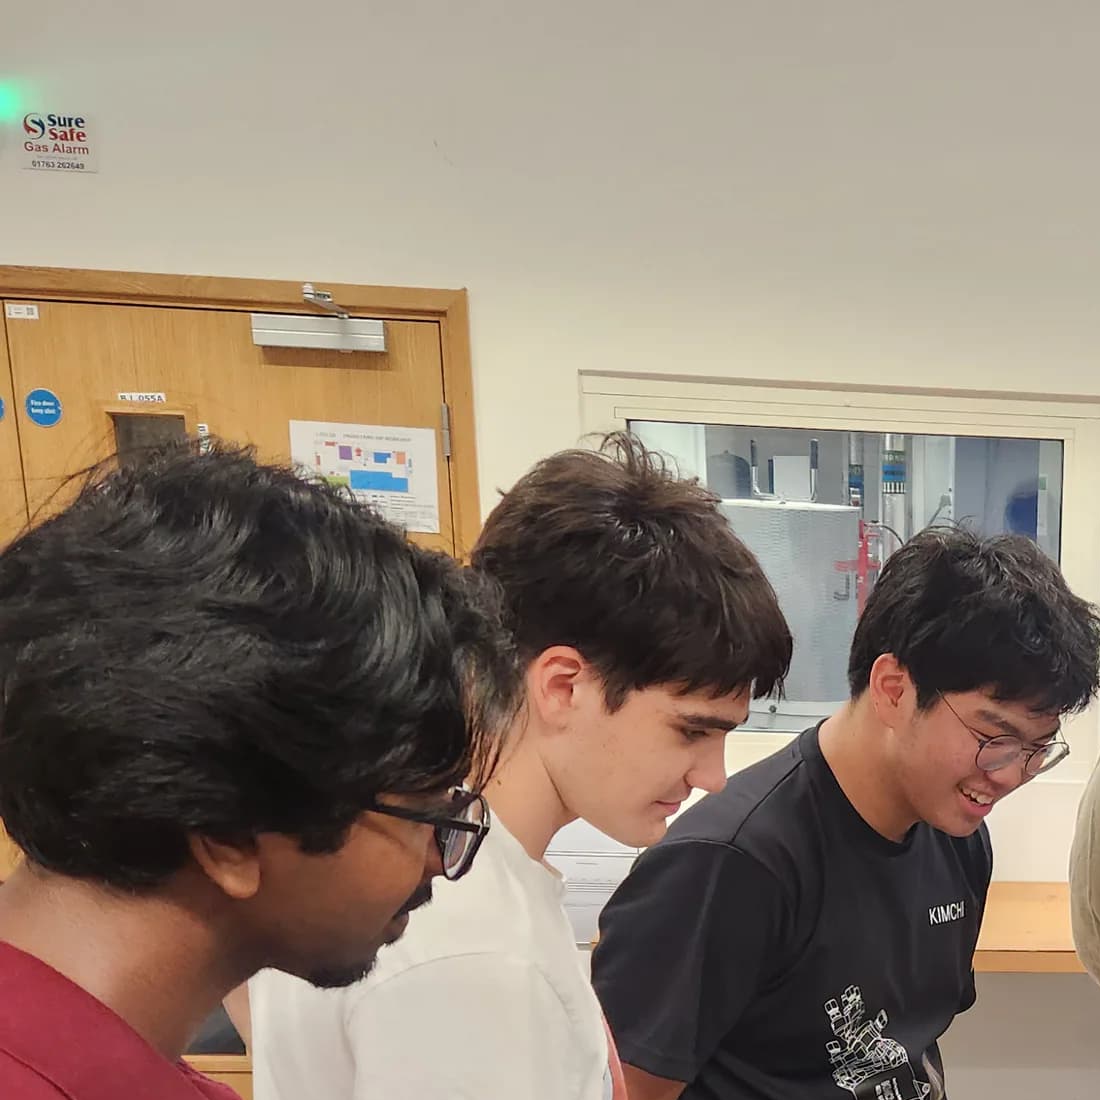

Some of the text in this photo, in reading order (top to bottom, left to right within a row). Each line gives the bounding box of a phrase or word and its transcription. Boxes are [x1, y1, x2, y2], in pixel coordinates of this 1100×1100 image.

[47, 114, 85, 128] Sure
[48, 128, 87, 142] Safe
[24, 141, 89, 155] Gas Alarm
[928, 900, 965, 926] KIMCHI
